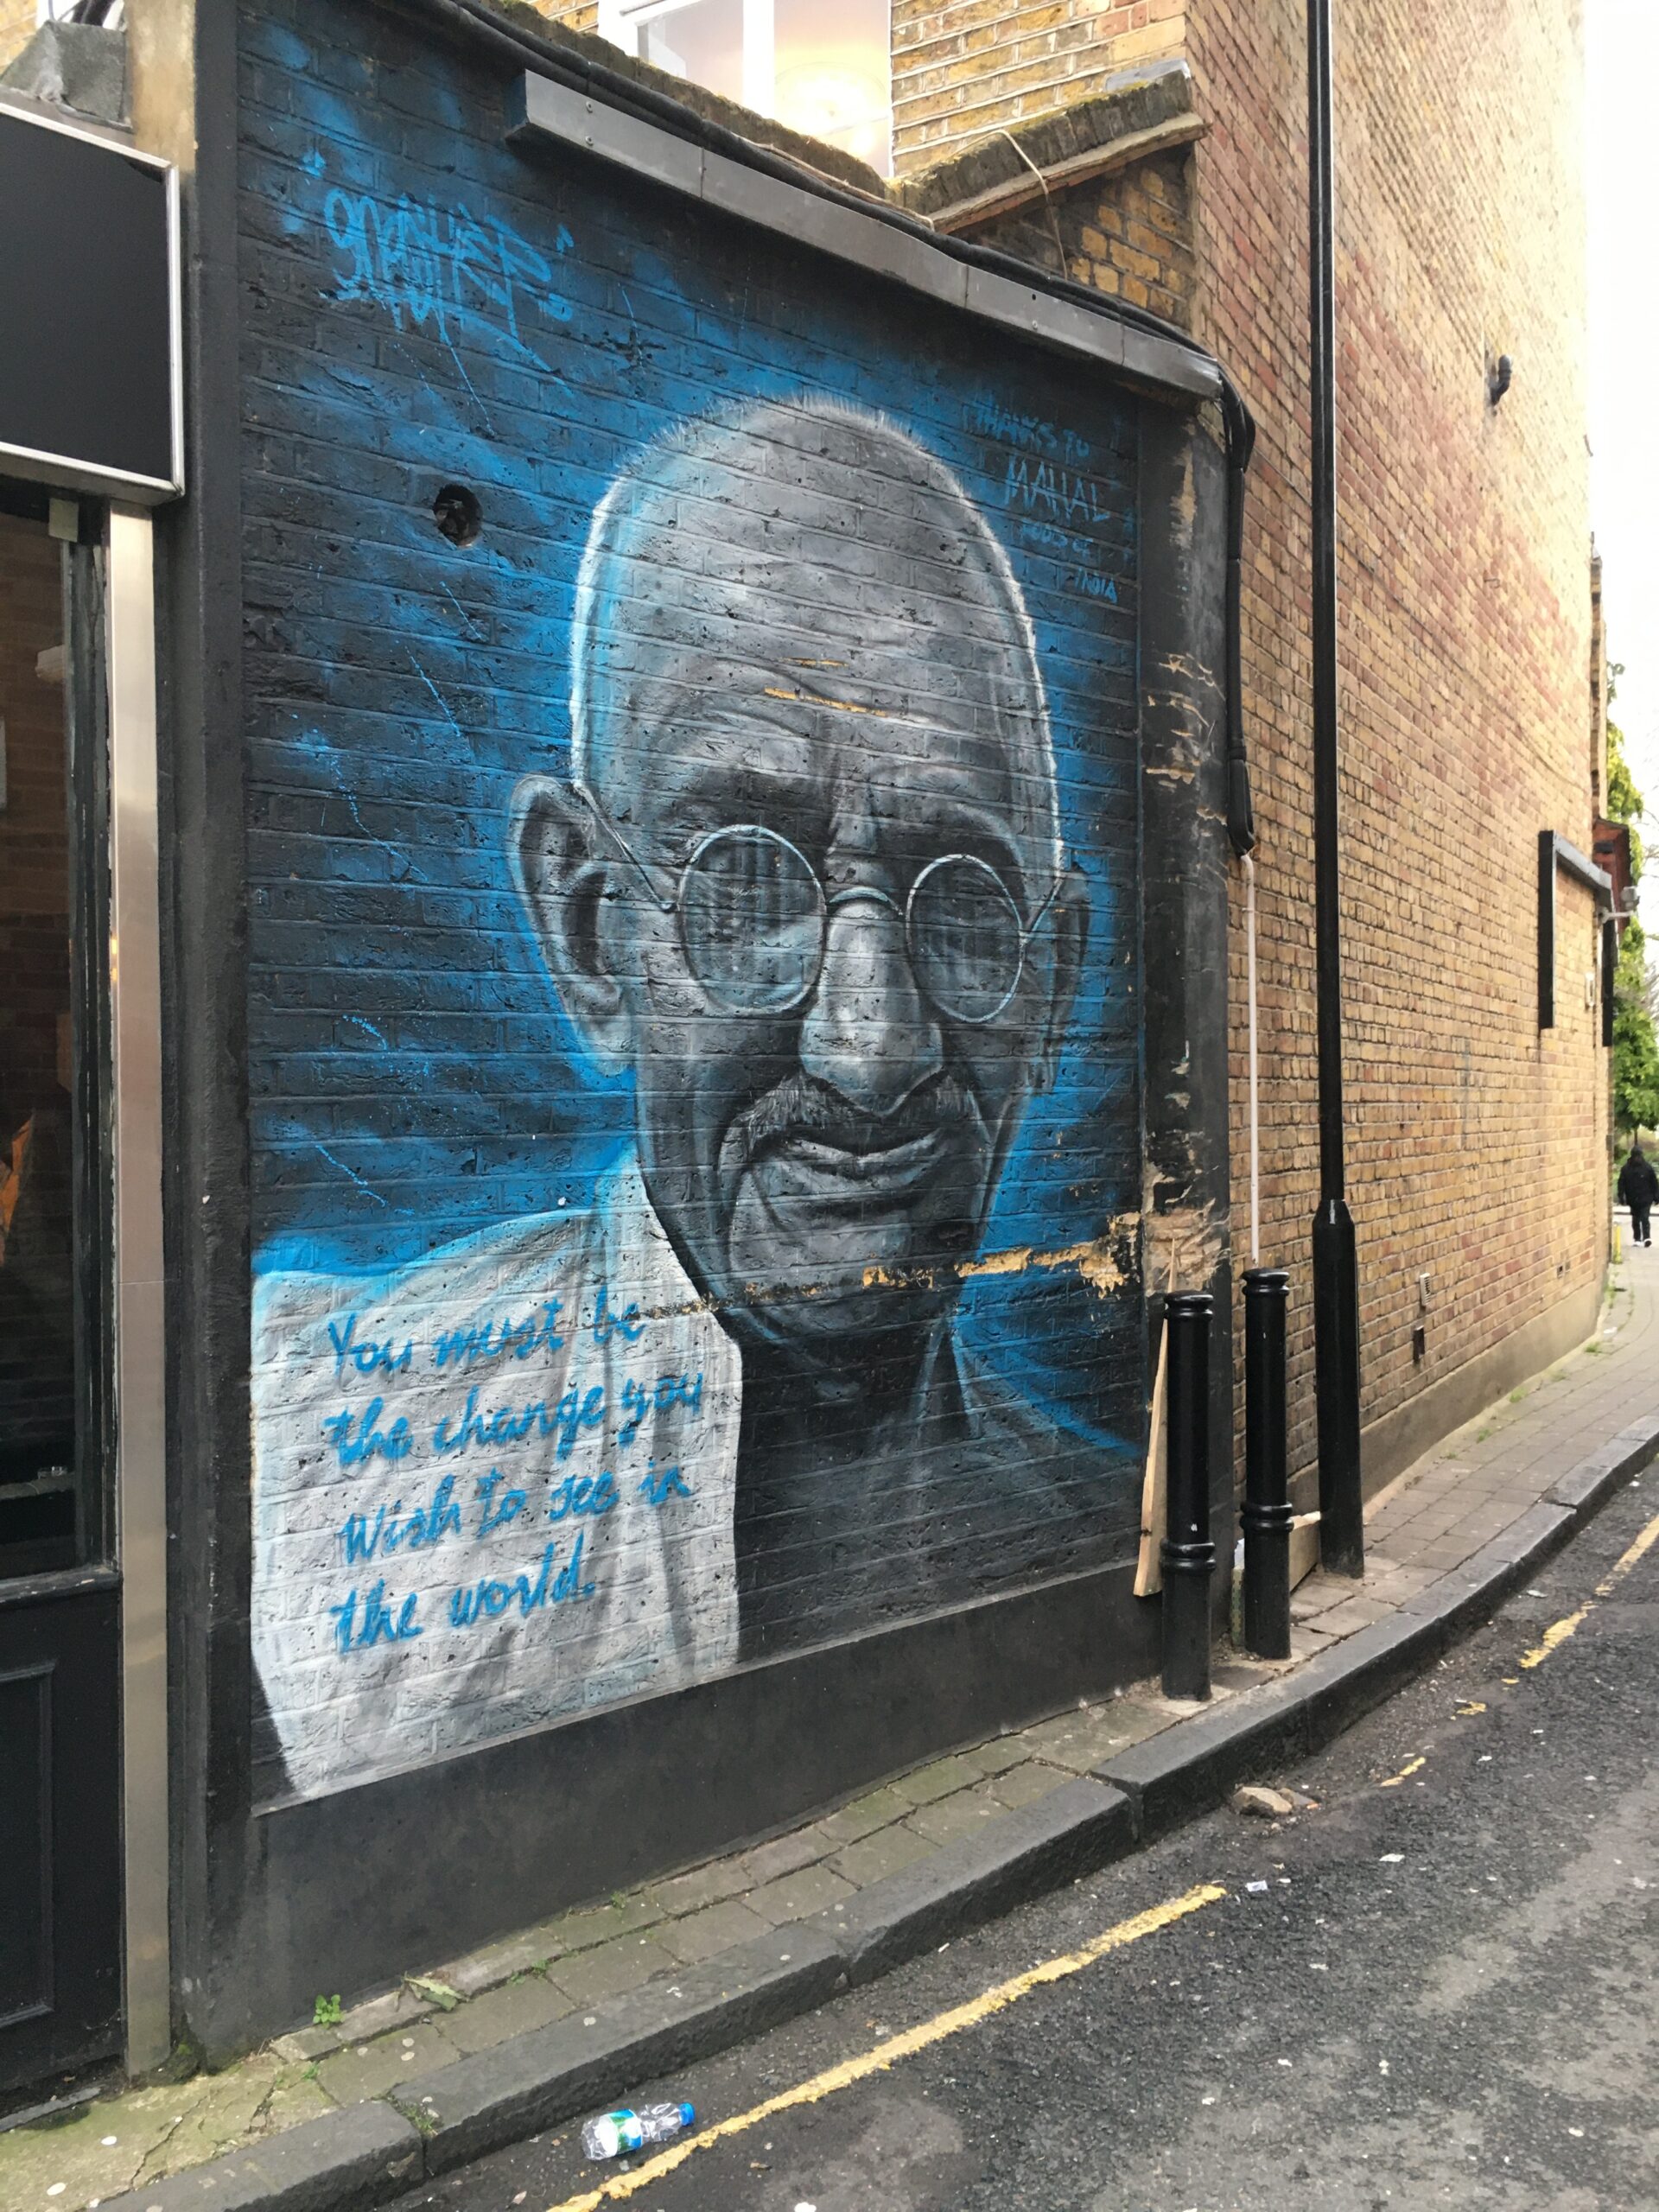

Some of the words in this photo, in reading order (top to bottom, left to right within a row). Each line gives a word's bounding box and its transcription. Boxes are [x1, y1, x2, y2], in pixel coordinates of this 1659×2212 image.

[962, 400, 1058, 451] THANKS
[1063, 429, 1090, 464] TO
[1075, 567, 1118, 604] INDIA
[329, 1313, 412, 1376] You
[436, 1296, 564, 1367] must
[594, 1285, 646, 1344] be
[324, 1396, 414, 1466] the
[434, 1385, 606, 1461] change
[619, 1372, 703, 1447] you
[478, 1466, 527, 1538] to
[550, 1470, 620, 1521] see
[639, 1460, 691, 1506] in
[331, 1579, 423, 1650] the
[450, 1532, 597, 1628] world.
